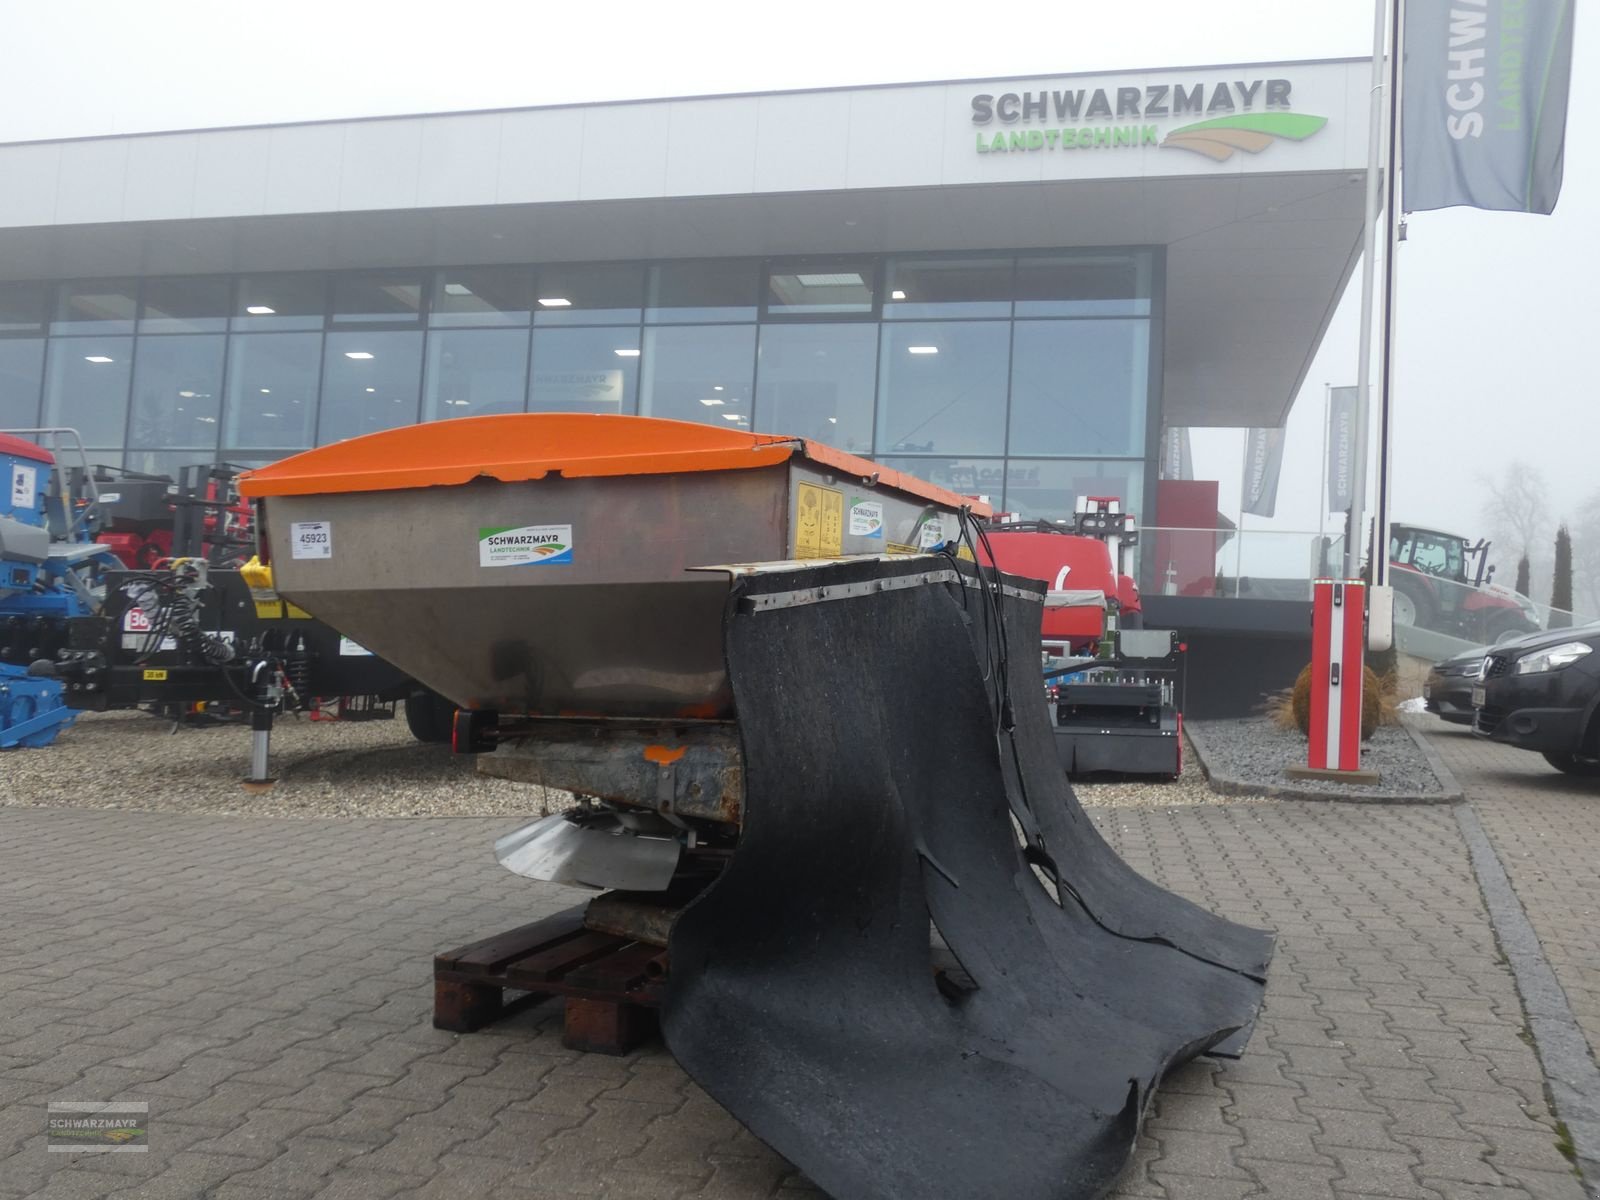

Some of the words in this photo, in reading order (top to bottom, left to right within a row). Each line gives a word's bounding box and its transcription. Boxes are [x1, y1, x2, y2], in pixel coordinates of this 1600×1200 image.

[1446, 0, 1487, 140] SCHW
[971, 78, 1292, 124] SCHWARZMAYR
[976, 124, 1159, 153] LANDTECHNIK
[1337, 411, 1348, 497] SCHWARZMAYR
[300, 533, 327, 543] 45923
[488, 534, 559, 545] SCHWARZMAYR
